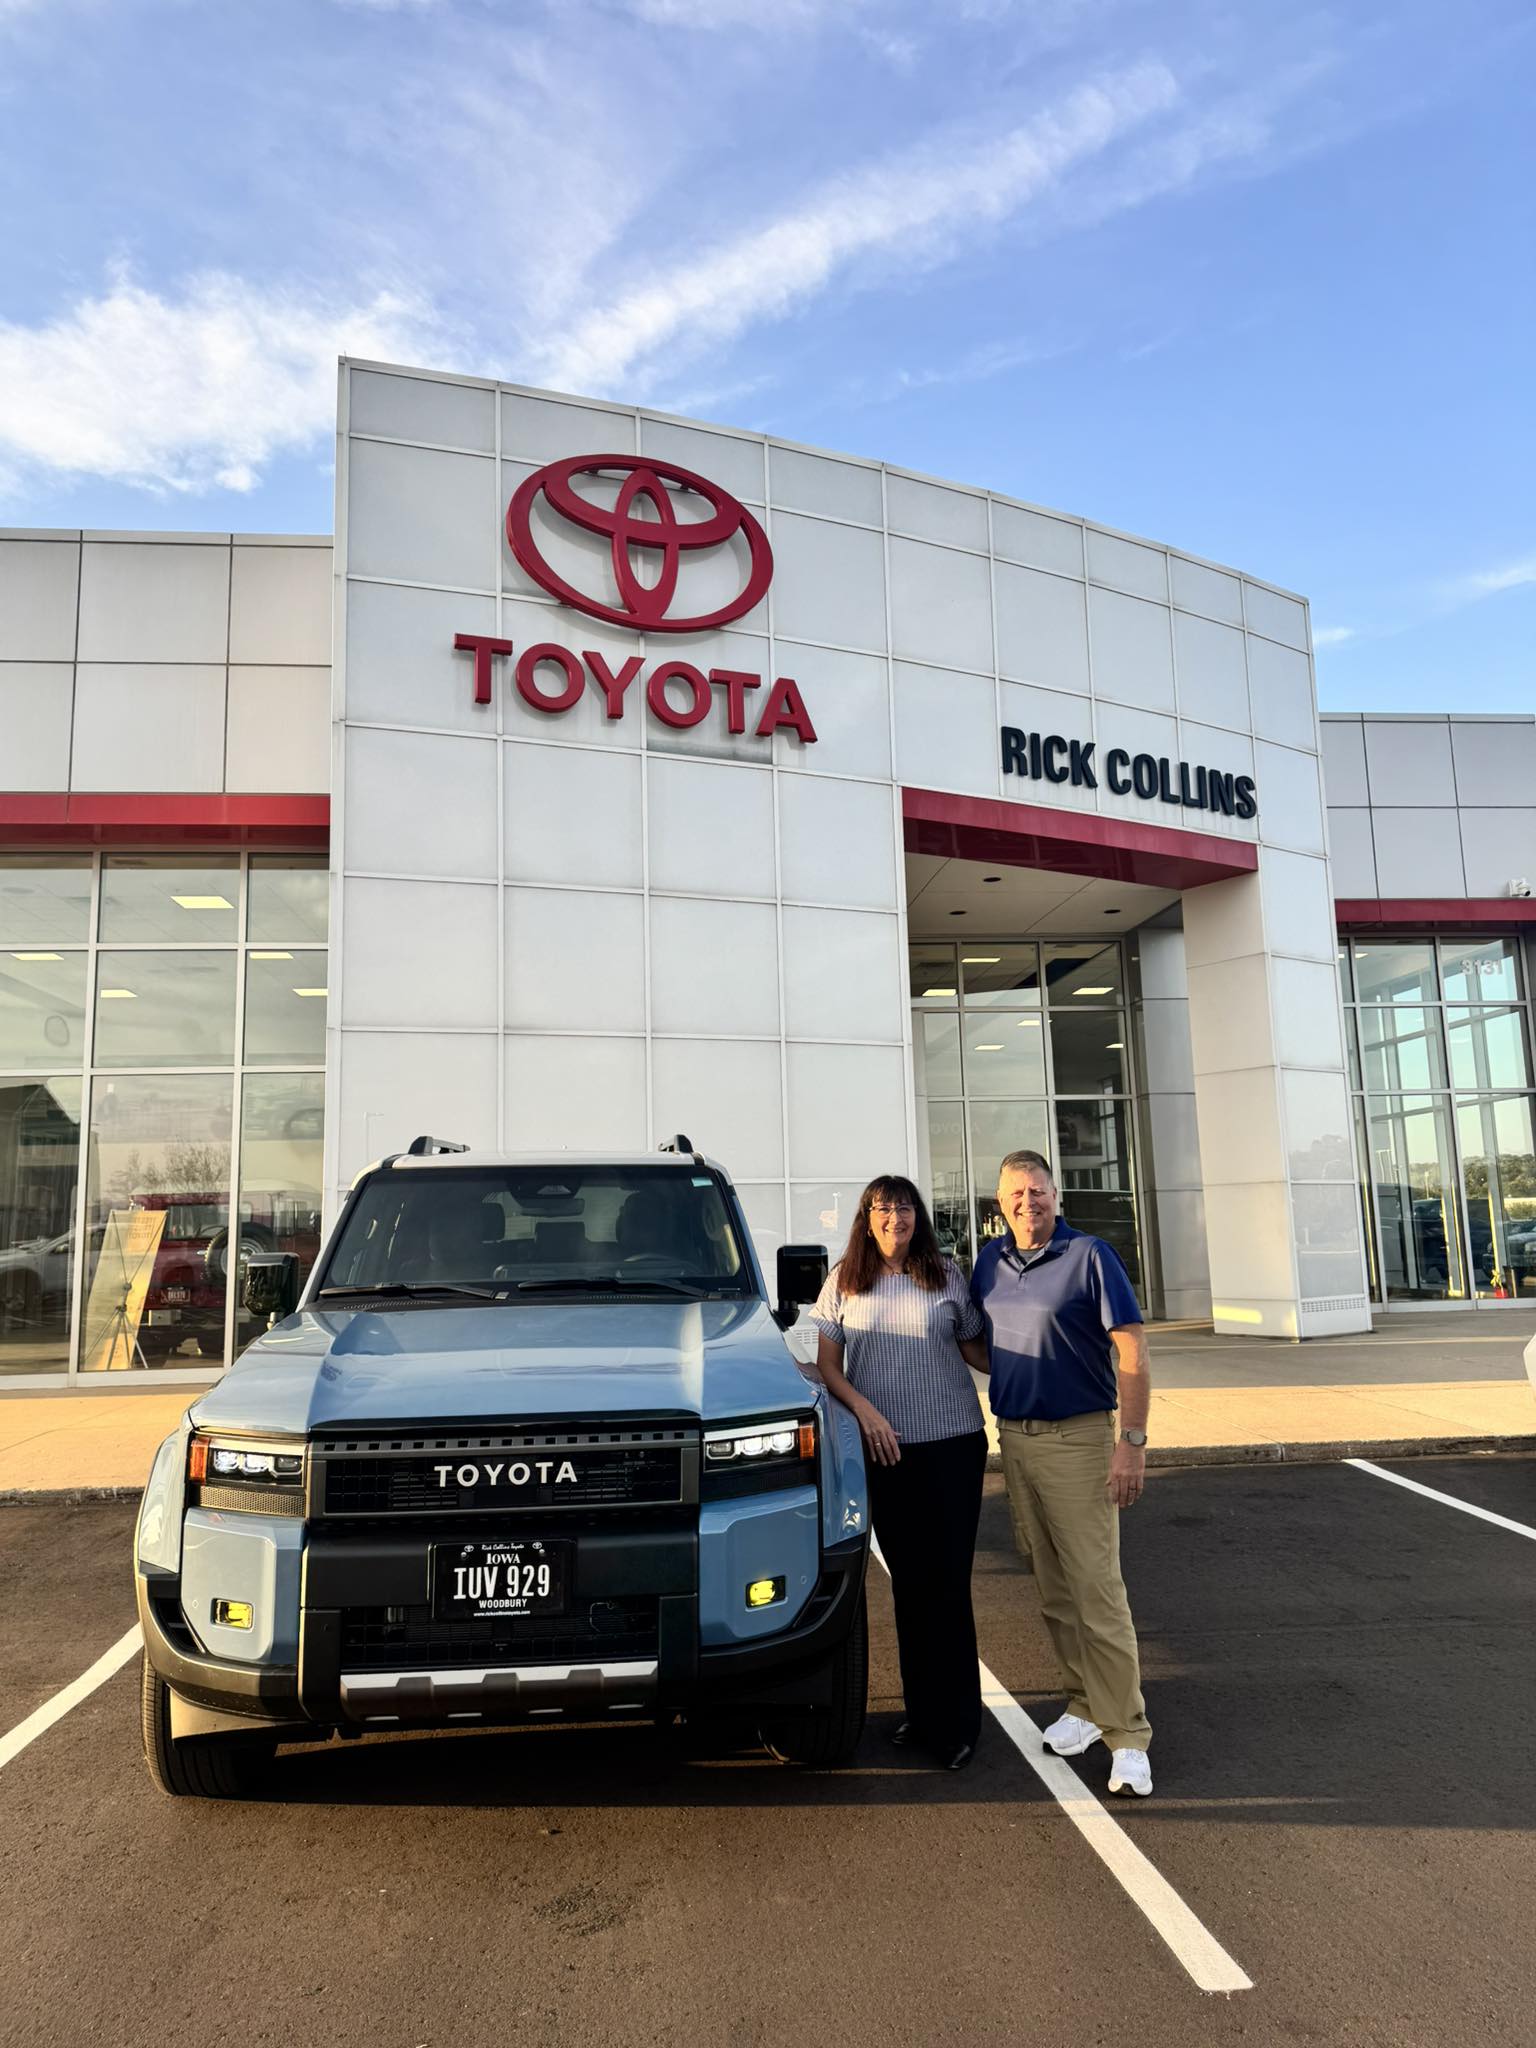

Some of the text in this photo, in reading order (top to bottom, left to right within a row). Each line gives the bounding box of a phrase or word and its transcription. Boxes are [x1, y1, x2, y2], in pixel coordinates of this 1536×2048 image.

[454, 633, 818, 743] TOYOTA
[1001, 726, 1257, 819] RICK COLLINS
[1460, 959, 1503, 976] 3131
[434, 1461, 577, 1487] TOYOTA
[486, 1552, 521, 1565] IOWA
[453, 1564, 550, 1600] IUV 929
[479, 1598, 528, 1609] WOODBURY
